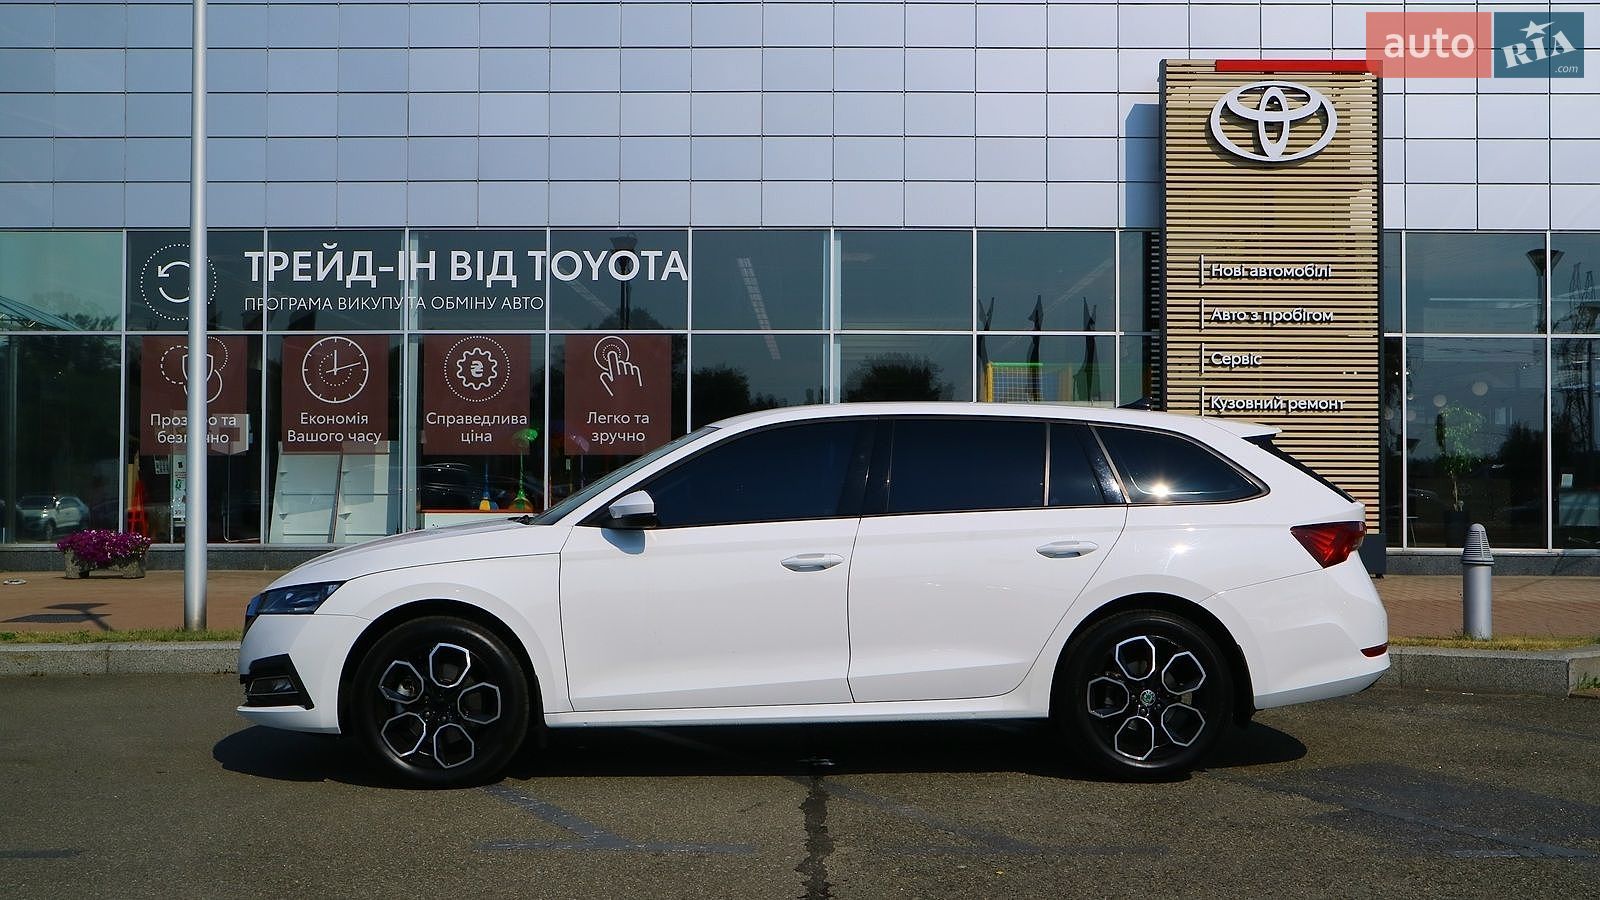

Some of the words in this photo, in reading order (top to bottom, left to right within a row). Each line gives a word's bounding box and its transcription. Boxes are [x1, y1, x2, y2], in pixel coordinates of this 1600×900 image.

[450, 250, 517, 288] ВІД
[1210, 264, 1246, 277] Нові
[1250, 263, 1332, 278] автомобілі
[245, 297, 333, 311] ПРОГРАМА
[338, 297, 404, 310] ВИКУПУ
[407, 297, 426, 309] ТА
[431, 296, 497, 310] ОБМІНУ
[501, 297, 544, 310] АВТО
[1211, 308, 1247, 321] Авто
[1250, 311, 1259, 321] з
[1263, 308, 1334, 324] пробігом
[1211, 352, 1263, 368] Сервіс
[1211, 396, 1285, 411] Кузовний
[1288, 401, 1346, 412] ремонт
[150, 413, 218, 429] Прозо
[221, 416, 237, 426] та
[300, 411, 369, 425] Економія
[426, 412, 528, 427] Справедлива
[587, 411, 630, 425] Легко
[634, 414, 650, 425] та
[287, 429, 344, 443] Вашого
[347, 431, 382, 445] часу
[461, 430, 493, 443] ціна
[591, 430, 646, 443] зручно
